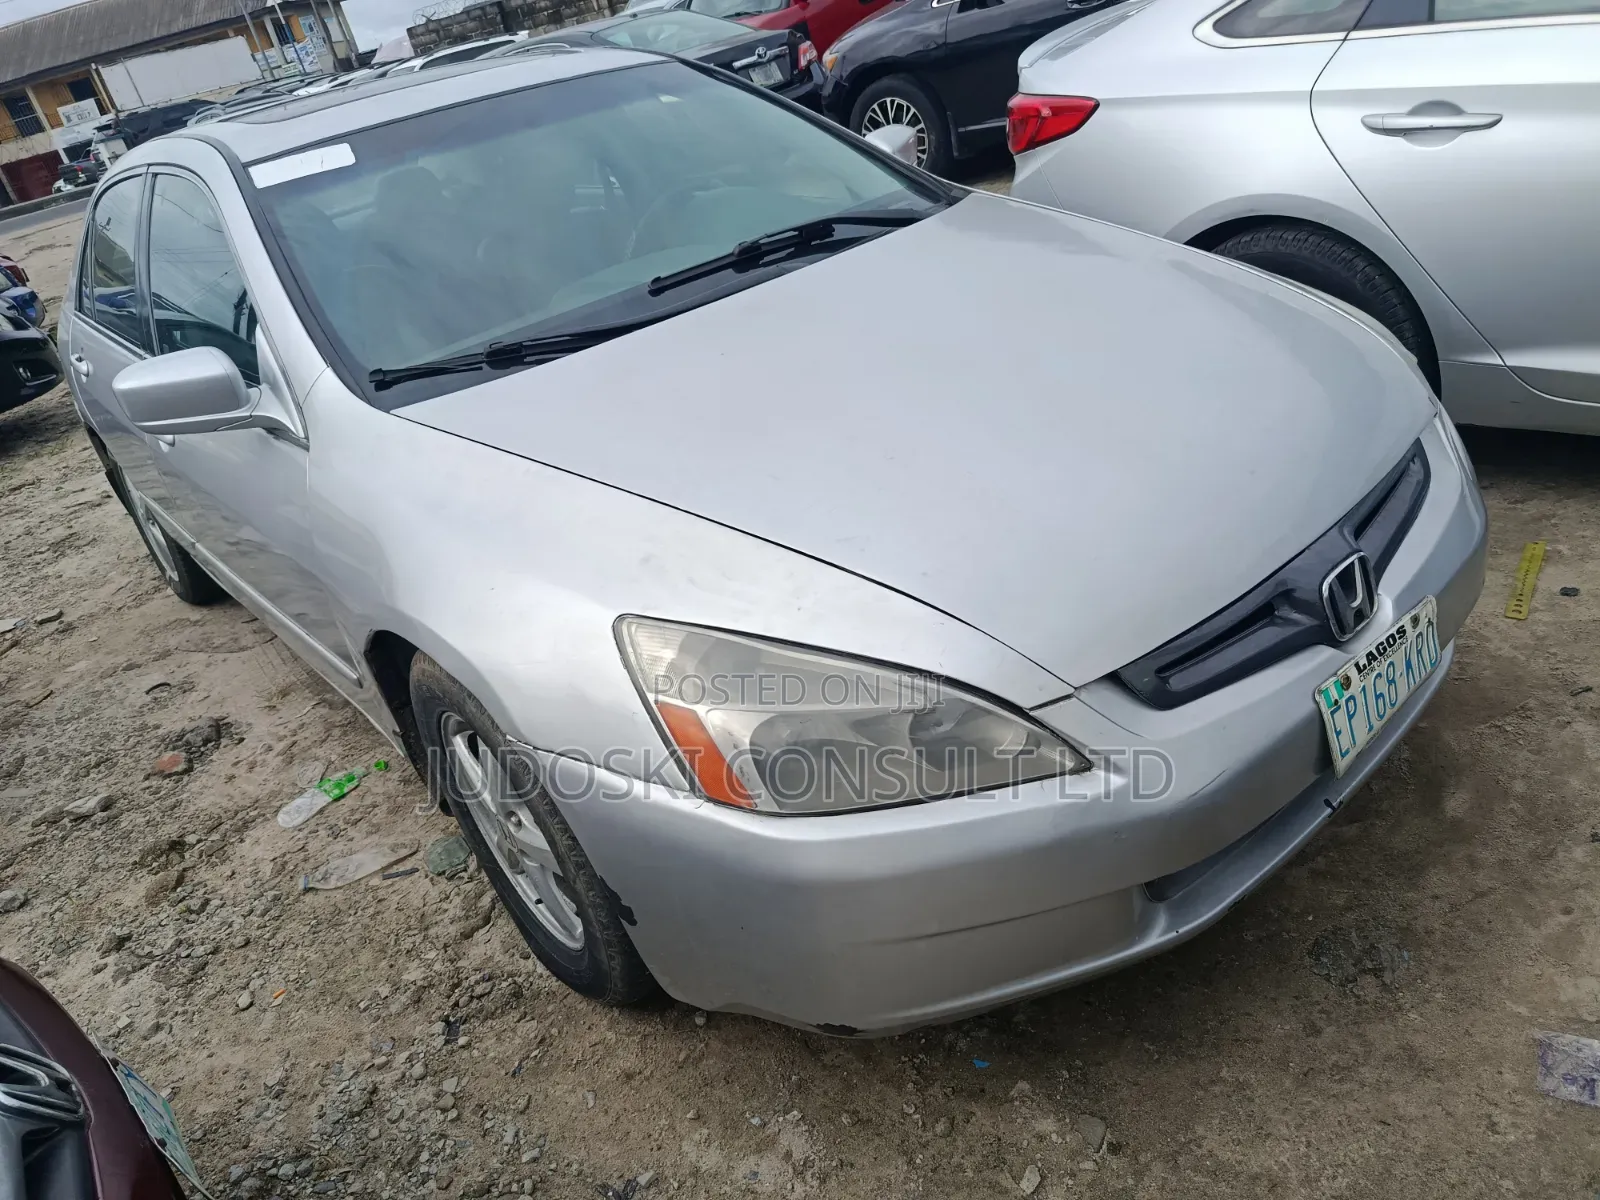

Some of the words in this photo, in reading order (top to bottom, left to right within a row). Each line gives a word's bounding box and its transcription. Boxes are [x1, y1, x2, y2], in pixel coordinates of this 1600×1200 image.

[1353, 624, 1407, 676] LAGOS
[1359, 664, 1378, 683] CENTRE
[1376, 660, 1384, 669] OF
[1383, 635, 1409, 663] EXCELLENCE
